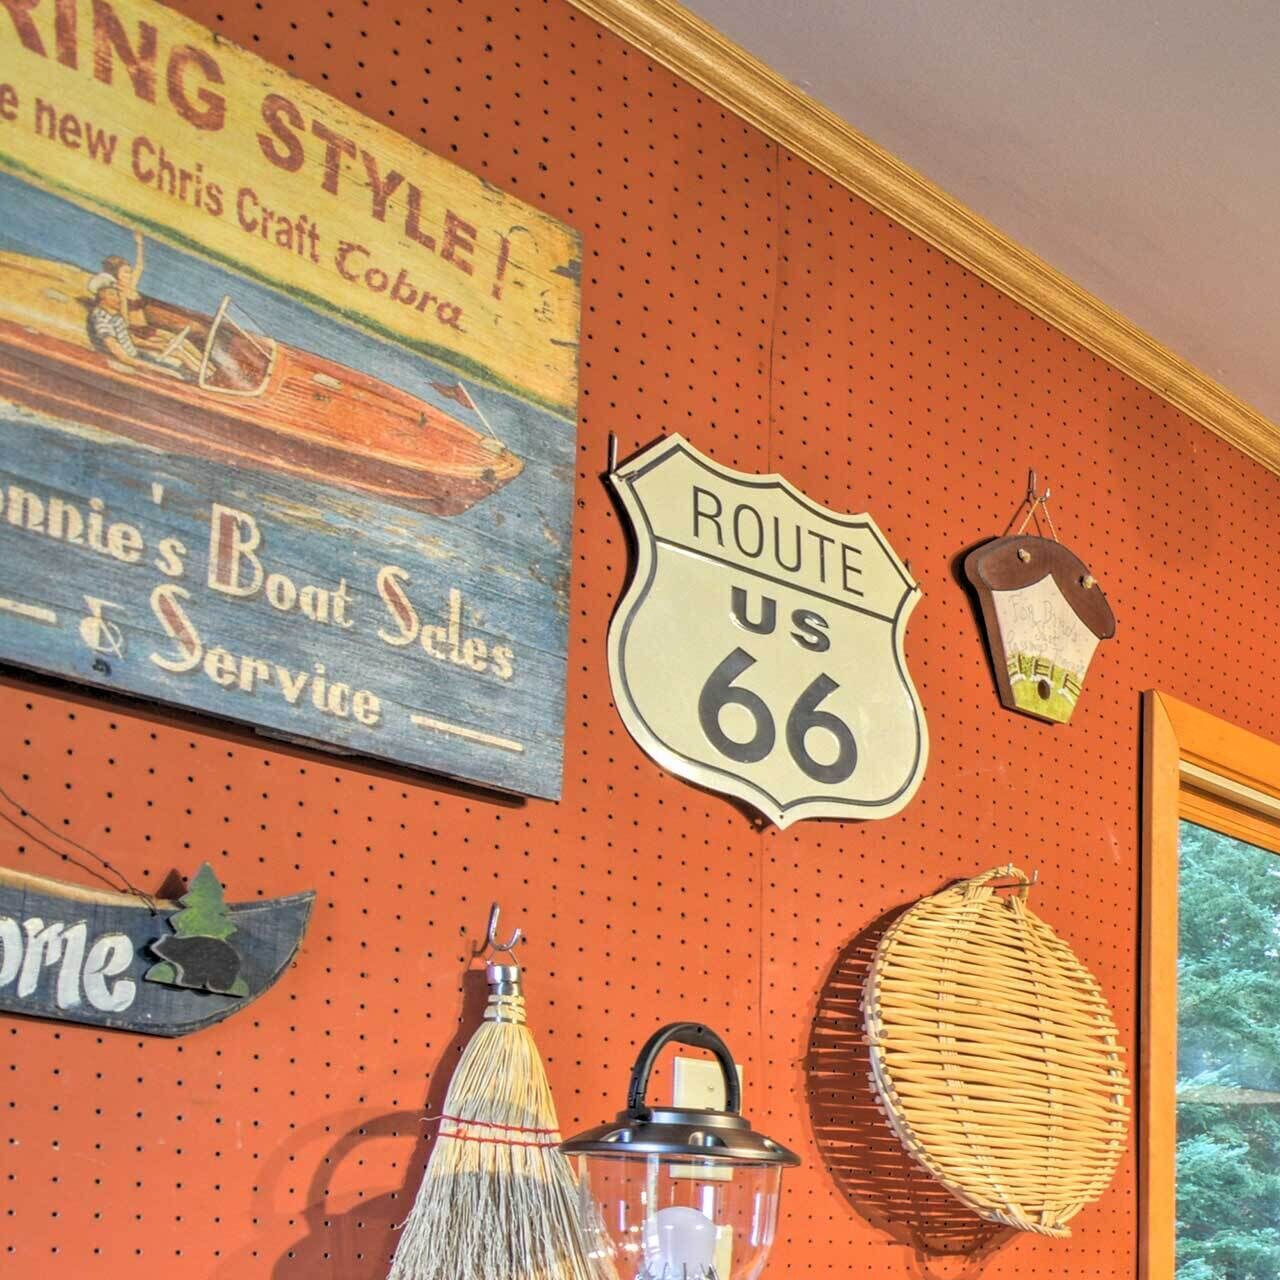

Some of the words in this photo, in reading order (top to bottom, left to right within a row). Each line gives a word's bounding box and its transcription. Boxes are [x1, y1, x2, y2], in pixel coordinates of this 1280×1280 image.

[35, 96, 117, 164] new
[131, 135, 225, 217] Chris
[236, 187, 322, 264] Craft
[335, 239, 467, 333] Cobra
[0, 482, 187, 577] nnie's
[208, 502, 356, 628] Boat
[376, 565, 516, 681] Sales
[692, 485, 866, 598] ROUTE
[149, 583, 383, 726] Service
[730, 585, 831, 653] US
[697, 646, 859, 786] 66
